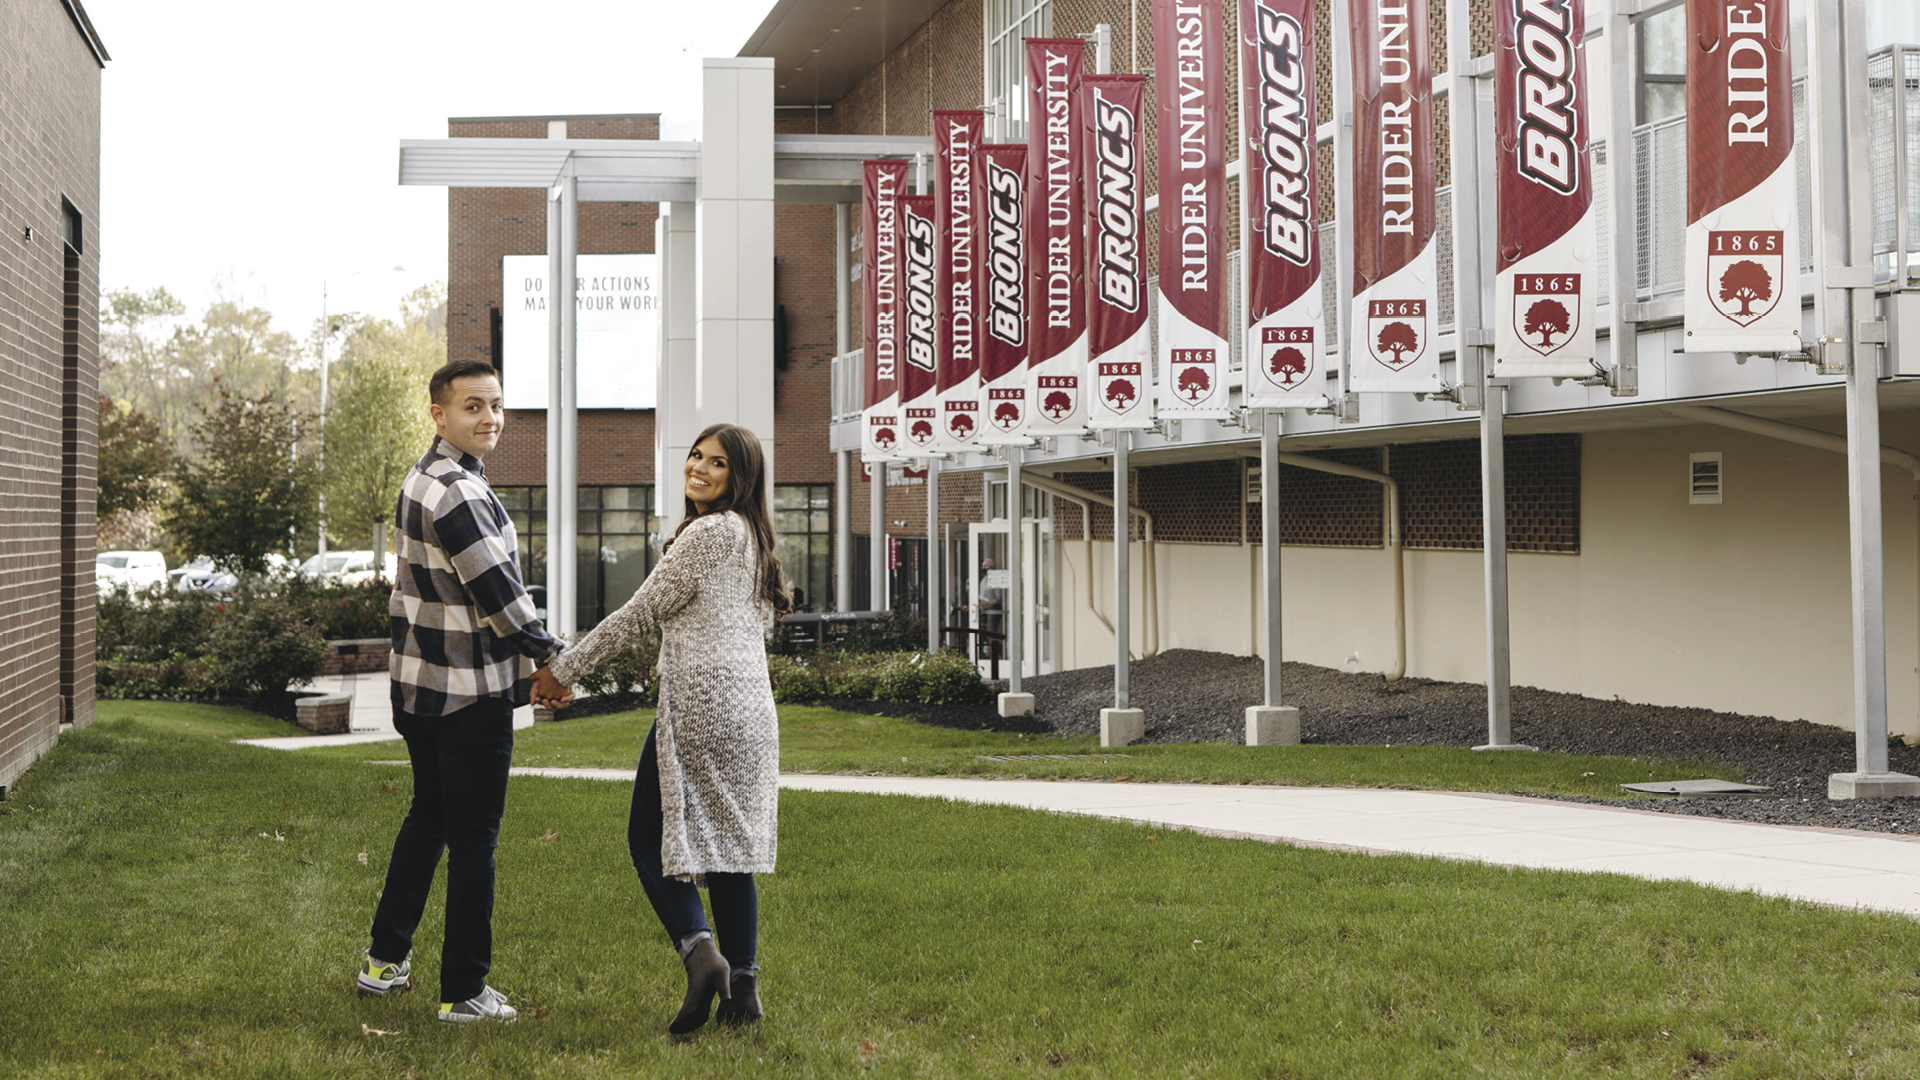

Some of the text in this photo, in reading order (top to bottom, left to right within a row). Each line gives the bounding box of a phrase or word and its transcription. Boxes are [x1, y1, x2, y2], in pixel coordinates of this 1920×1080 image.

[1727, 0, 1768, 148] RIDE
[1256, 4, 1311, 266] BRONCS
[1176, 0, 1208, 292] RIDER UNIVERSI
[1381, 97, 1413, 236] RIDER
[1046, 49, 1071, 329] RIDER UNIVERSITY
[1095, 96, 1140, 313] BRONCS
[949, 119, 973, 360] RIDER UNIVERSITY
[1715, 235, 1776, 252] 1865
[988, 161, 1023, 347] BRONCS
[877, 169, 895, 381] RIDER UNIVERSITY
[525, 277, 543, 292] DO
[592, 276, 650, 291] ACTIONS
[1520, 277, 1574, 292] 1865
[905, 212, 937, 373] BRONCS
[576, 295, 614, 311] YOUR
[620, 295, 657, 310] WOR
[1374, 302, 1421, 316] 1865
[1266, 329, 1309, 342] 1865
[1174, 351, 1213, 362] 1865
[1102, 365, 1138, 375] 1865
[1042, 377, 1075, 387] 1865
[991, 389, 1022, 399] 1865
[908, 409, 935, 418] 1865
[948, 402, 977, 411] 1865
[872, 416, 898, 425] 1865
